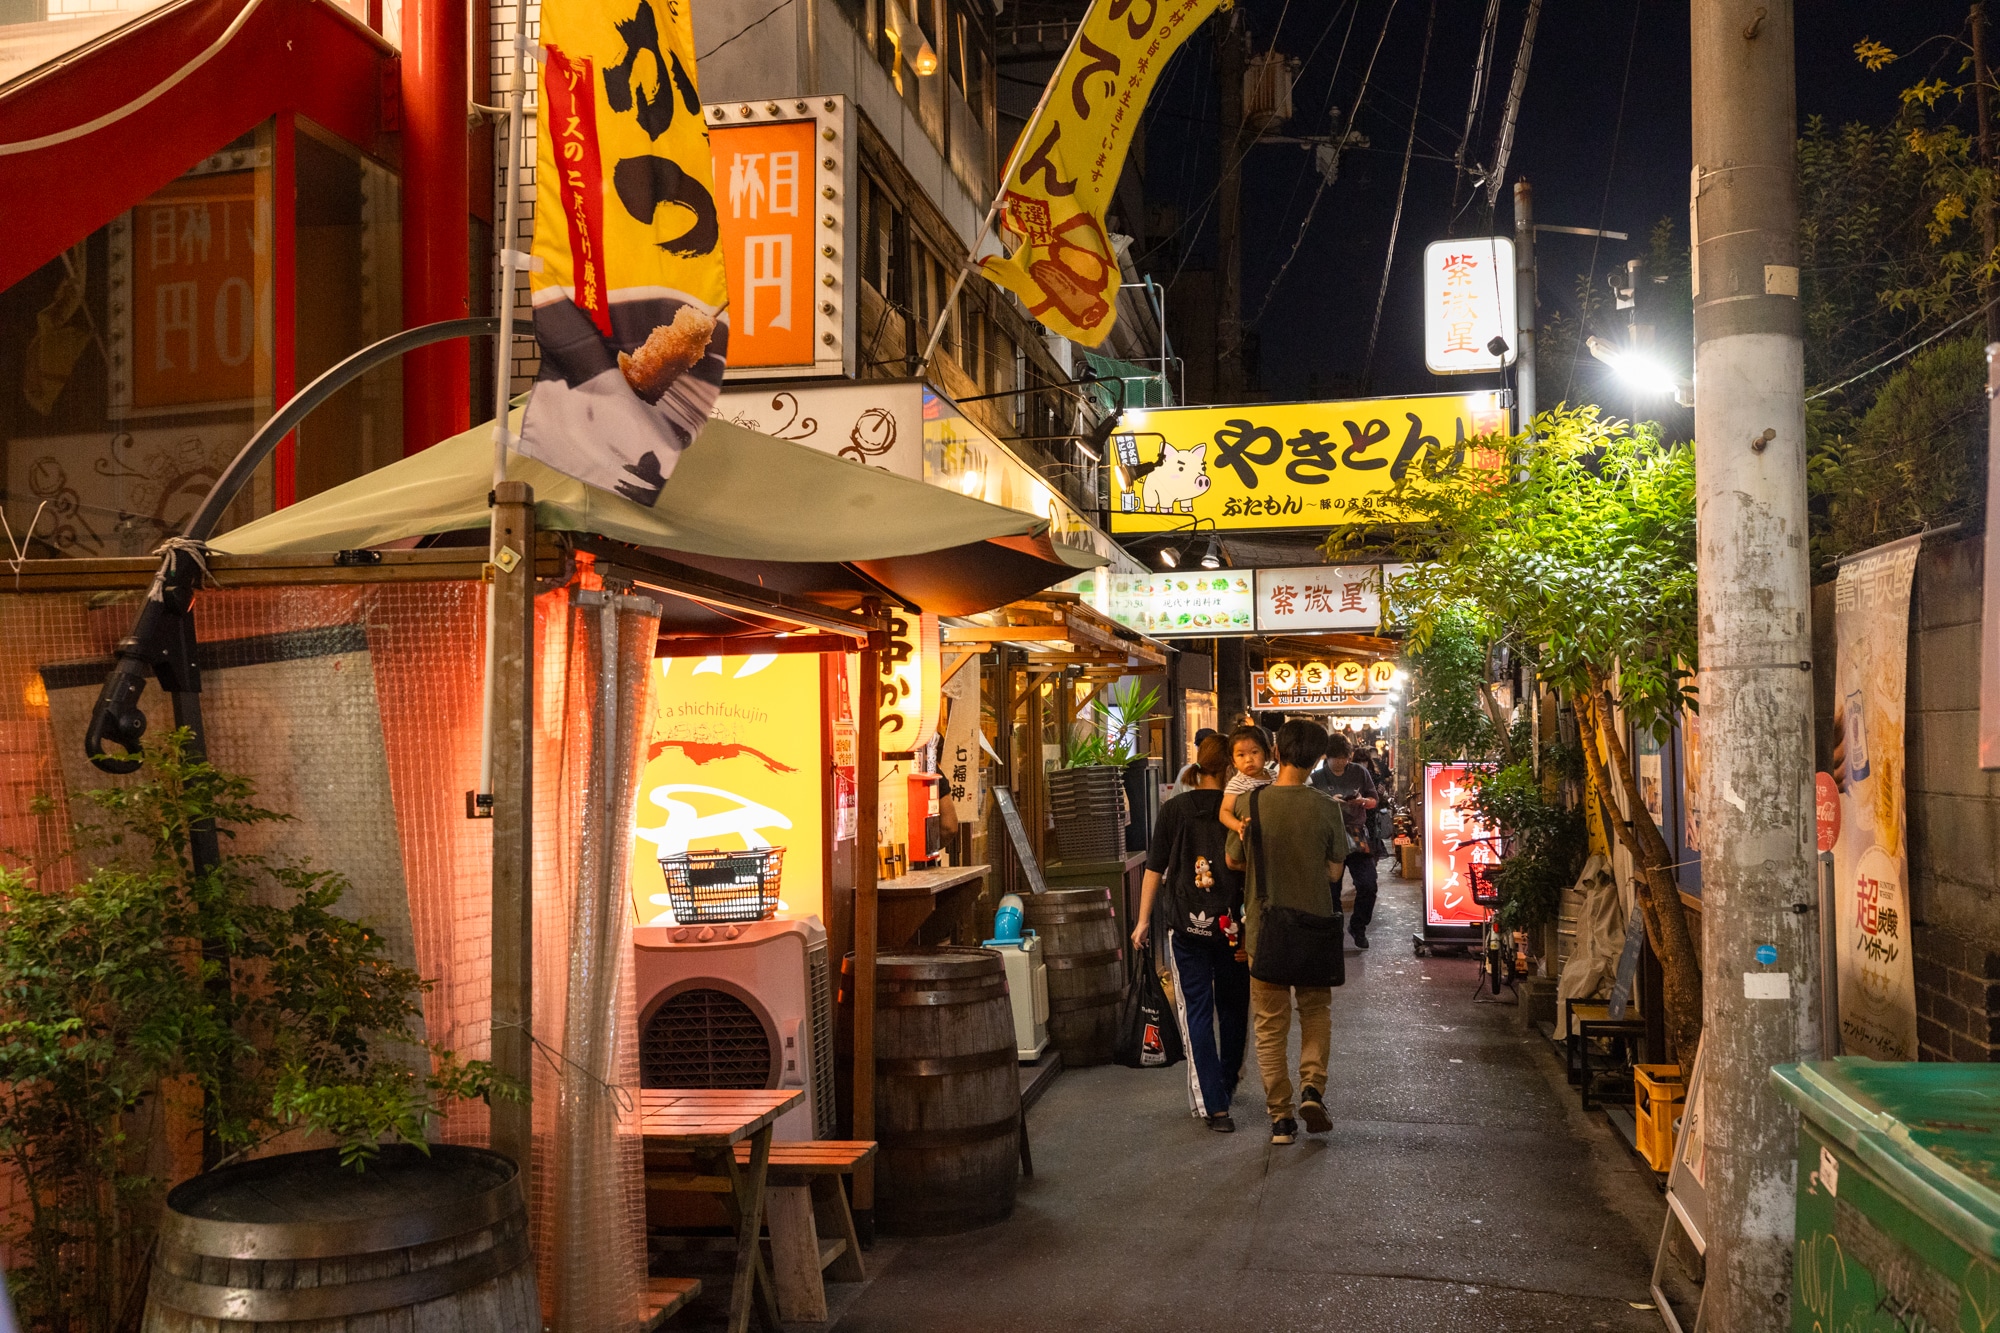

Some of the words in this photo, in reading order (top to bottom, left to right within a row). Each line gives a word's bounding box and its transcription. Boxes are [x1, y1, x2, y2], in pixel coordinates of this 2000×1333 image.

[1214, 412, 1465, 489] やきとん
[1271, 584, 1368, 615] 紫微星
[678, 701, 768, 723] shichifukujin
[951, 744, 968, 803] 七福神
[1439, 781, 1464, 909] 中国ラーメン
[1856, 873, 1878, 936] 超
[1187, 927, 1213, 936] adidas
[1857, 933, 1899, 964] ハイボール
